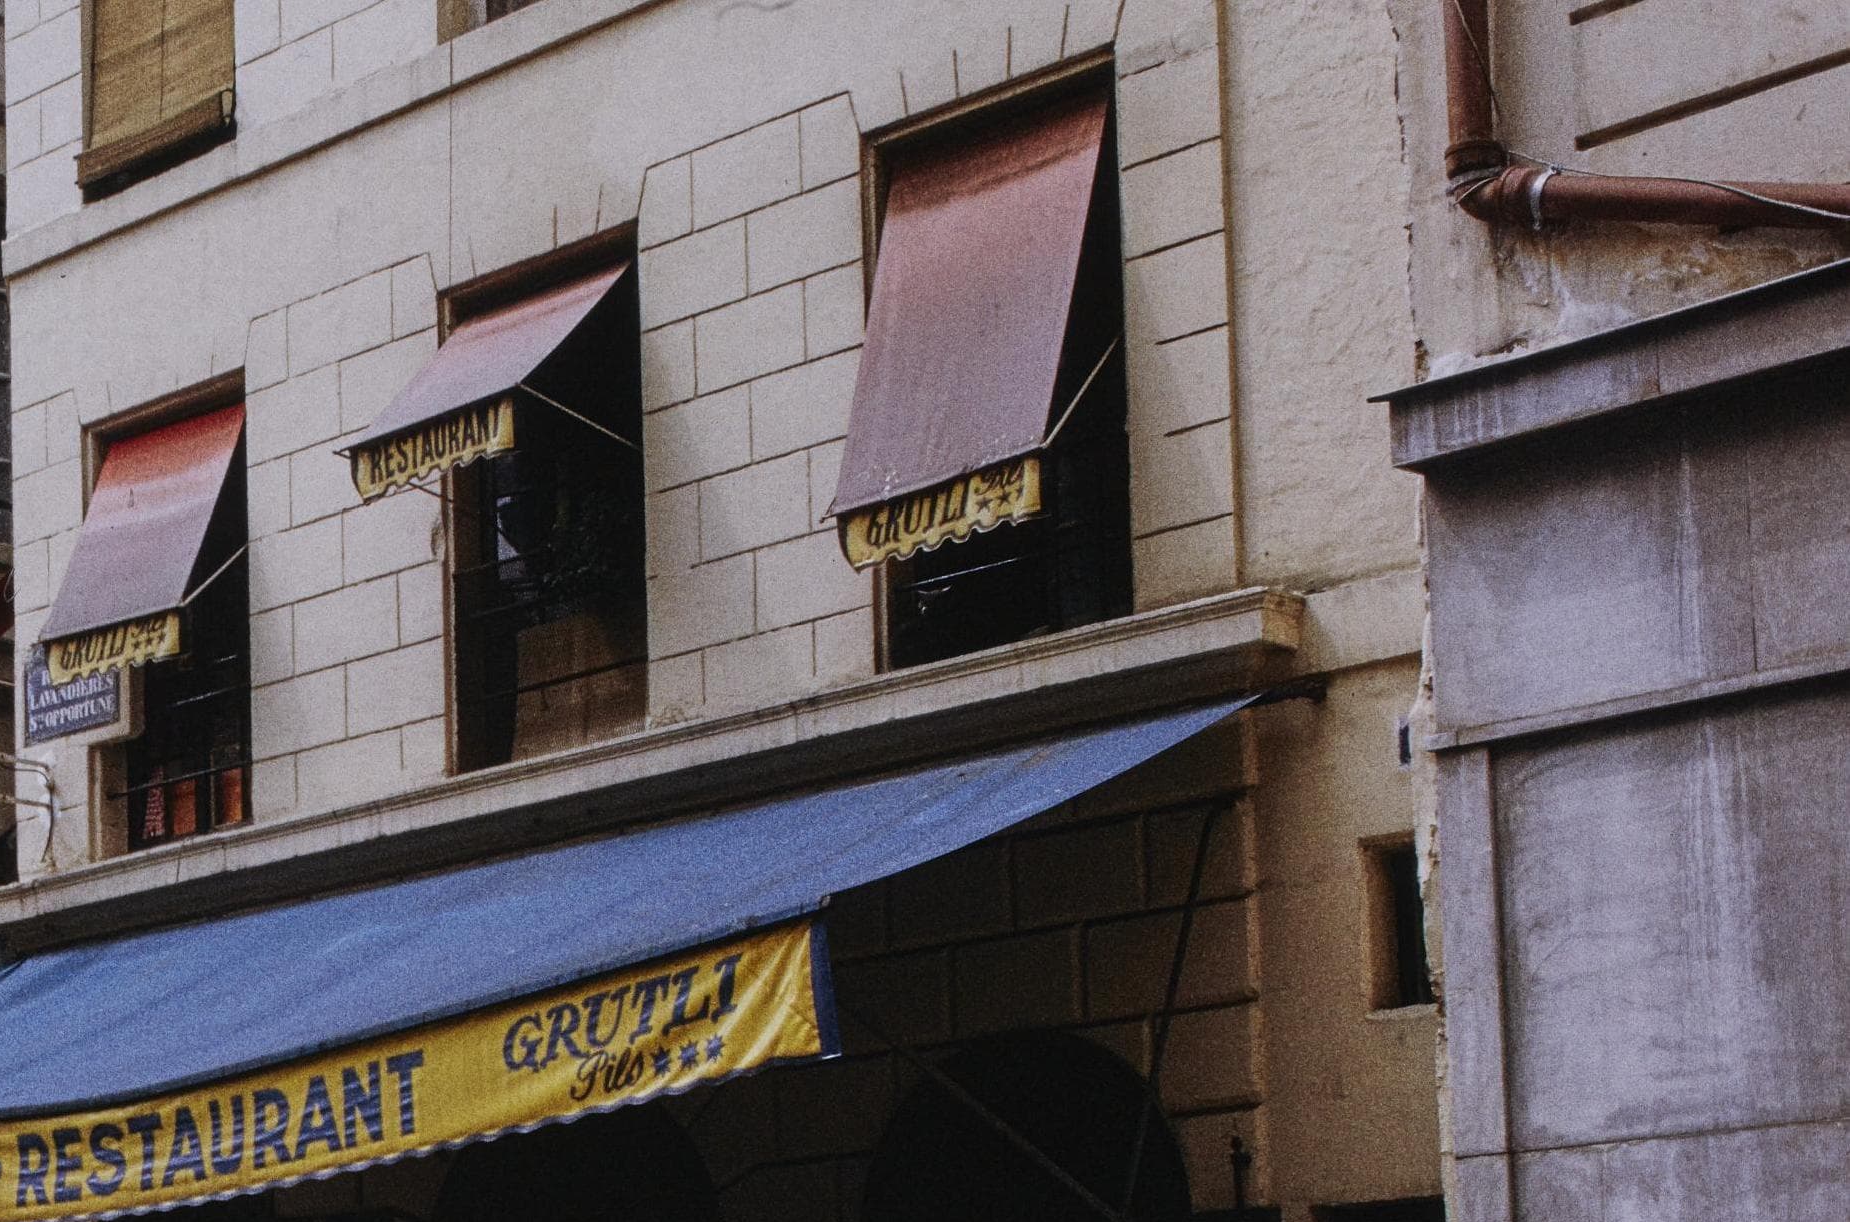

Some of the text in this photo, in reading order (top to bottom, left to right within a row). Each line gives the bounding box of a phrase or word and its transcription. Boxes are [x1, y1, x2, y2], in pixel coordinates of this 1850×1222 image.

[501, 953, 745, 1102] GRUTLI Pils
[15, 1048, 427, 1208] RESTAURANT
